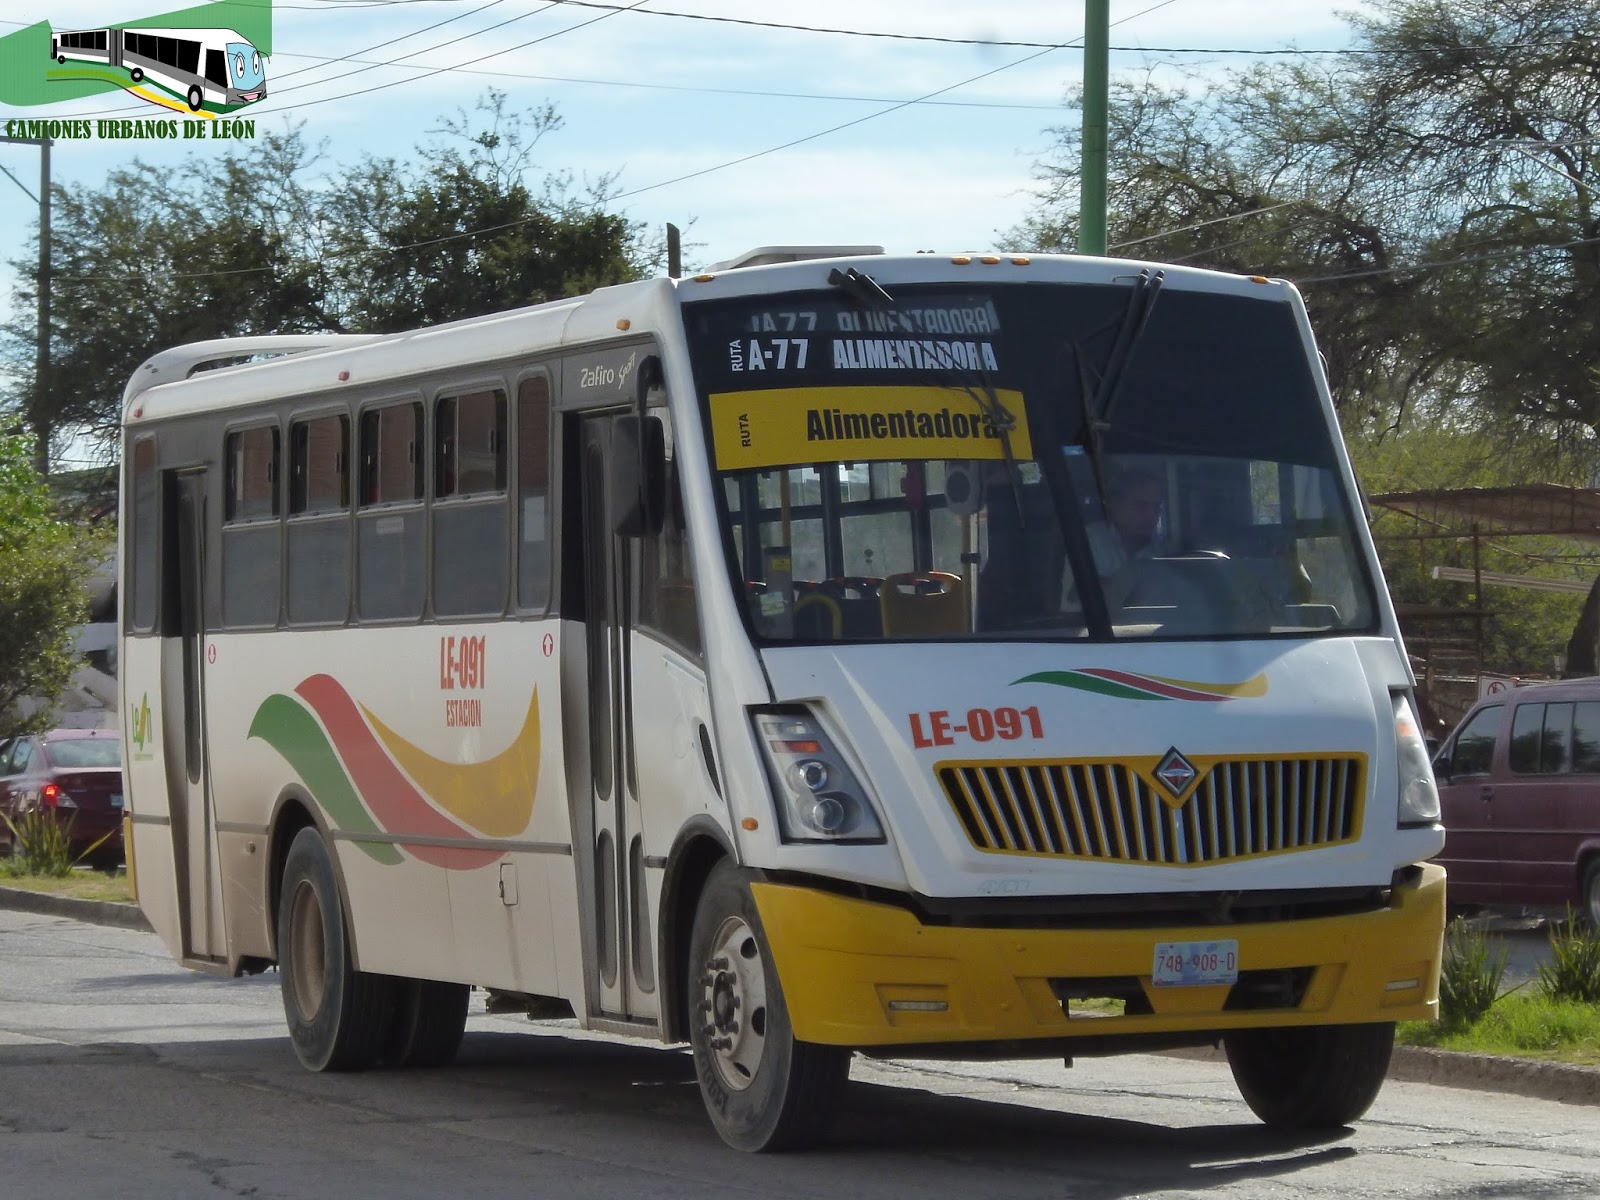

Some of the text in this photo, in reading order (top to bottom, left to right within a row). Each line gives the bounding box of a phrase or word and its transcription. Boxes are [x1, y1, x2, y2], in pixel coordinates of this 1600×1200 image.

[729, 339, 744, 372] RUTA
[748, 338, 999, 371] A-77 ALIMENTADORA
[580, 365, 615, 388] Zafiro
[738, 413, 752, 447] RUTA
[806, 408, 1001, 442] Alimentadora
[440, 635, 486, 690] LE-091
[446, 699, 481, 727] ESTACION
[908, 706, 1044, 749] LE-091
